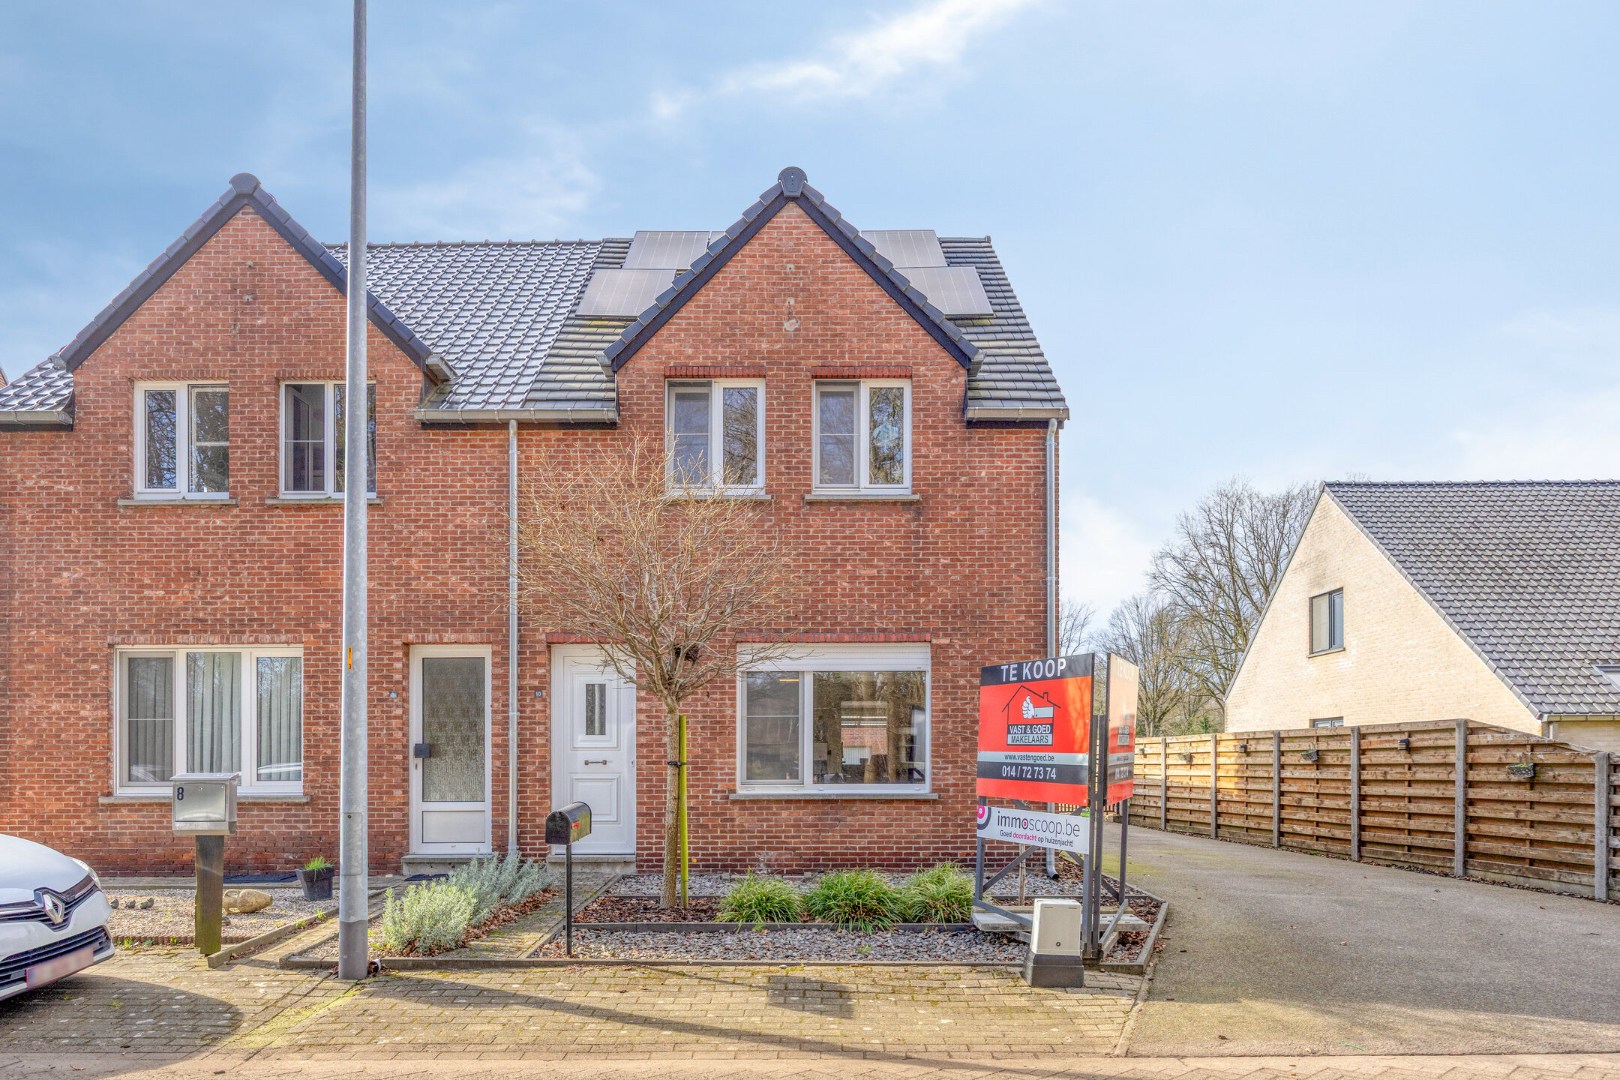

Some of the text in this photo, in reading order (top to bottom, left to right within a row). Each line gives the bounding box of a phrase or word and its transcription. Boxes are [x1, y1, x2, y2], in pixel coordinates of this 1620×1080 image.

[1001, 658, 1067, 682] TE KOOP
[1009, 725, 1051, 734] VAST & GOED
[1011, 735, 1049, 744] MAKELAARS
[1004, 753, 1055, 763] www.vastengoed.be
[1002, 765, 1016, 777] 014
[1022, 767, 1032, 779] 72
[1034, 767, 1044, 779] 73
[1046, 767, 1057, 780] 74
[177, 786, 184, 801] 8
[997, 810, 1081, 837] immoscoop.be
[1000, 829, 1013, 838] Goed
[1012, 832, 1037, 842] doordacht
[1038, 836, 1044, 844] op
